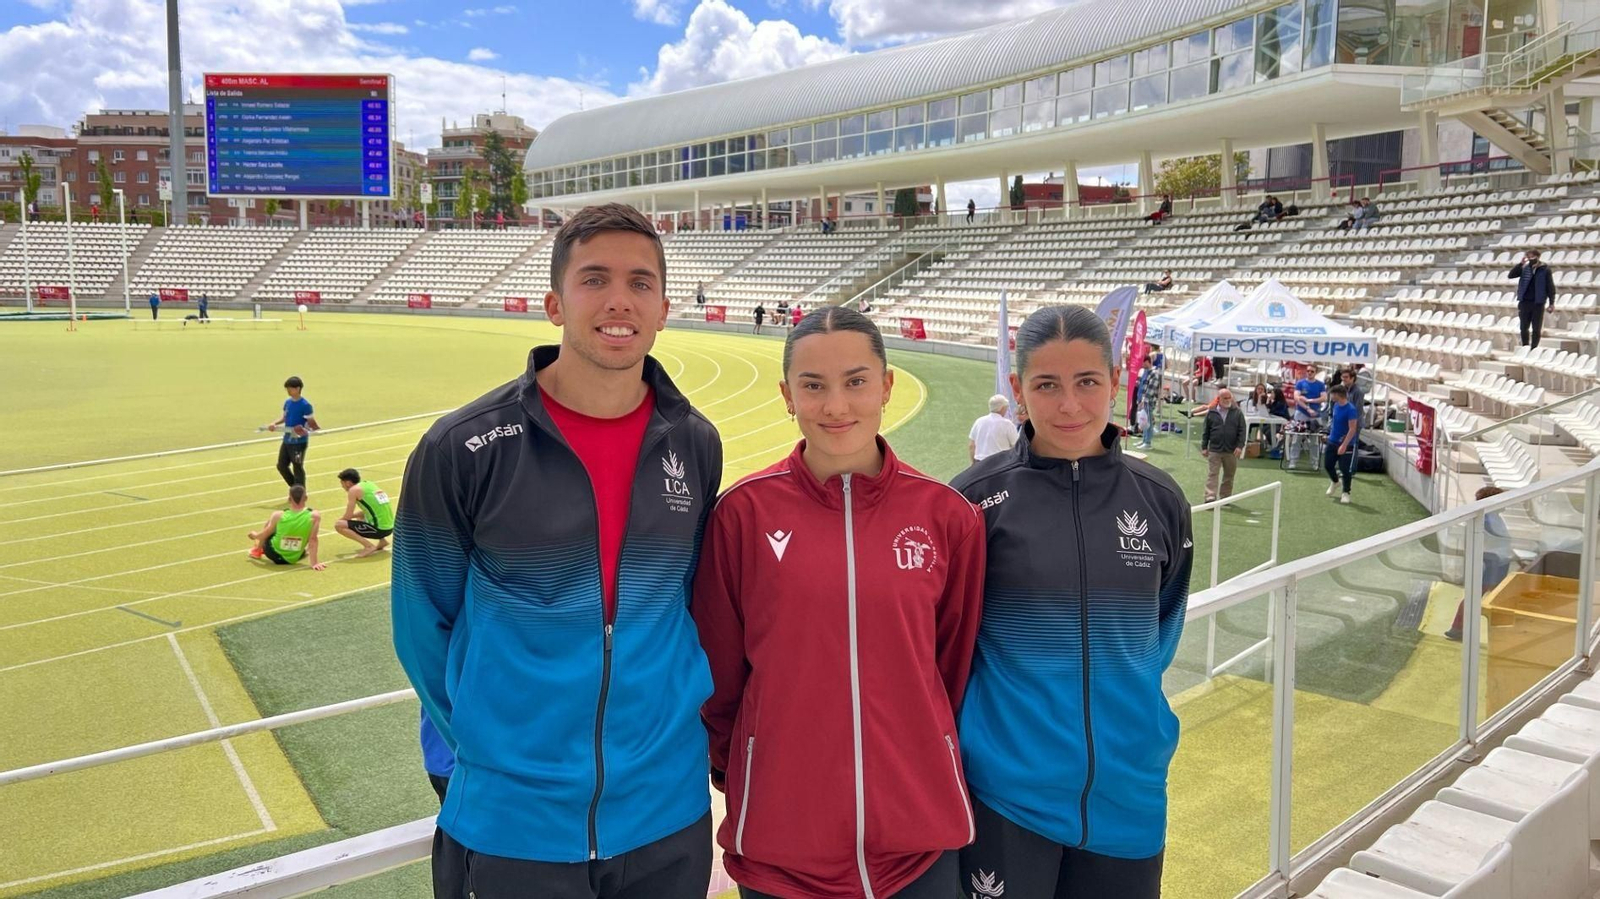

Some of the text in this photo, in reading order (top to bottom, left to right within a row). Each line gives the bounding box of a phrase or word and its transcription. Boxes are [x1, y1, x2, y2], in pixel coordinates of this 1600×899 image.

[1199, 337, 1307, 355] DEPORTES
[1312, 341, 1369, 357] UPM
[482, 422, 523, 446] rasán
[664, 478, 690, 496] UCA
[665, 497, 692, 506] Universidad
[1119, 536, 1152, 552] UCA
[1120, 553, 1154, 562] Universidad
[1134, 560, 1151, 568] Cádiz
